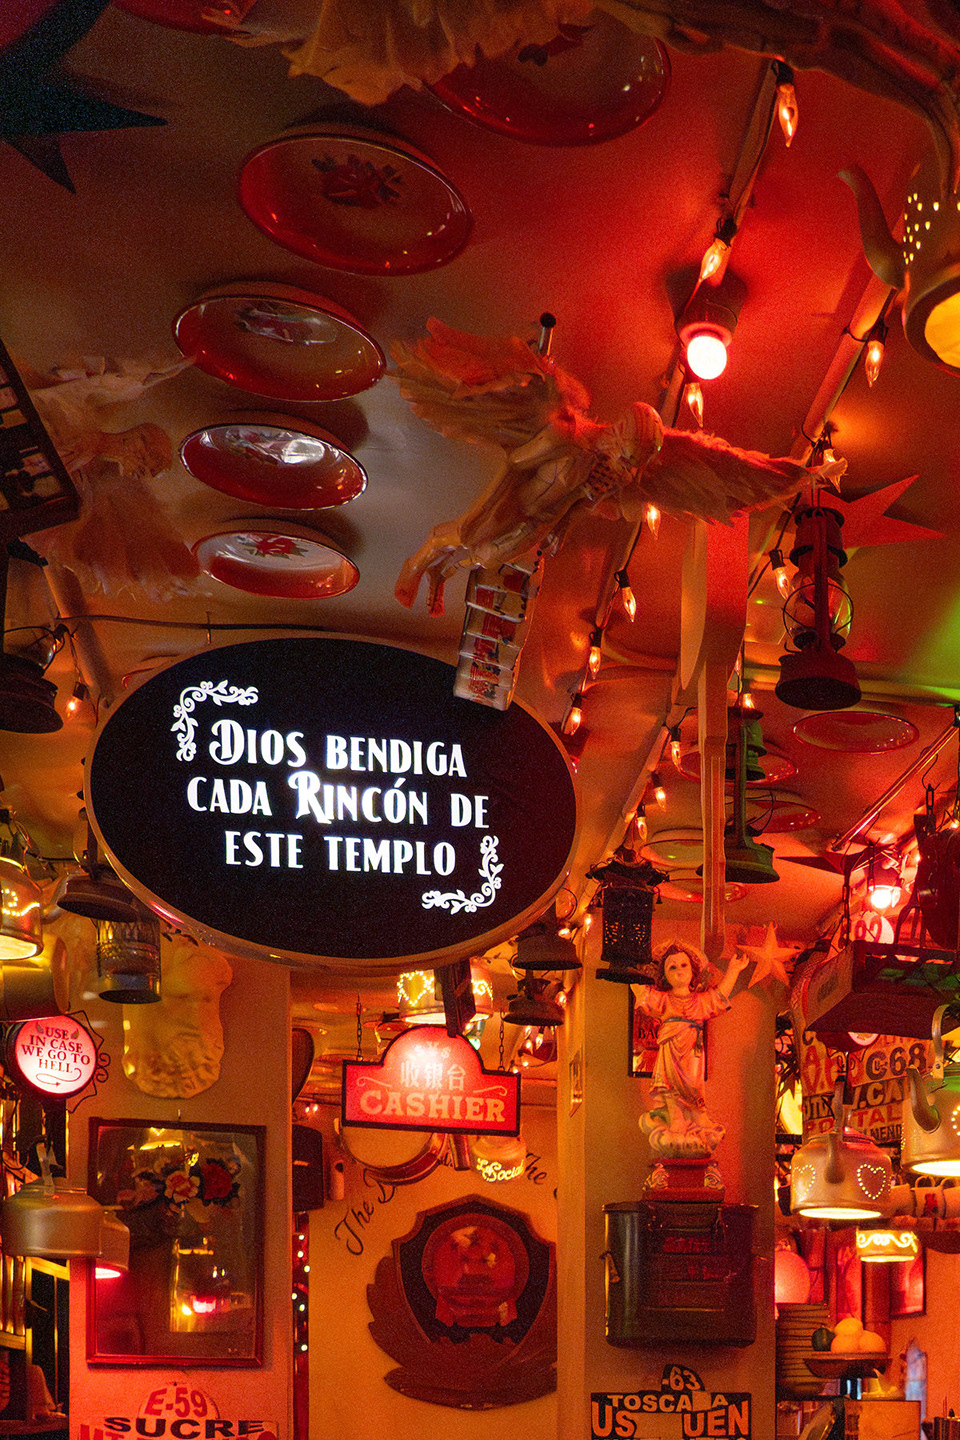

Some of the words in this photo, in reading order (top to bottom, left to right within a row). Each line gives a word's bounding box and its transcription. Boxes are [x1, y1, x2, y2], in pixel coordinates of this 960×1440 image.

[45, 1026, 70, 1040] USE
[21, 1044, 44, 1057] WE
[47, 1049, 67, 1061] GO
[71, 1052, 91, 1065] TO
[29, 1034, 46, 1047] IN
[50, 1039, 83, 1054] CASE
[38, 1058, 73, 1074] HELL
[401, 1060, 466, 1091] 收银台
[359, 1090, 506, 1122] CASHIER
[144, 1387, 208, 1418] E-59
[607, 1394, 729, 1413] TOSCAA
[104, 1417, 265, 1439] SUCRE
